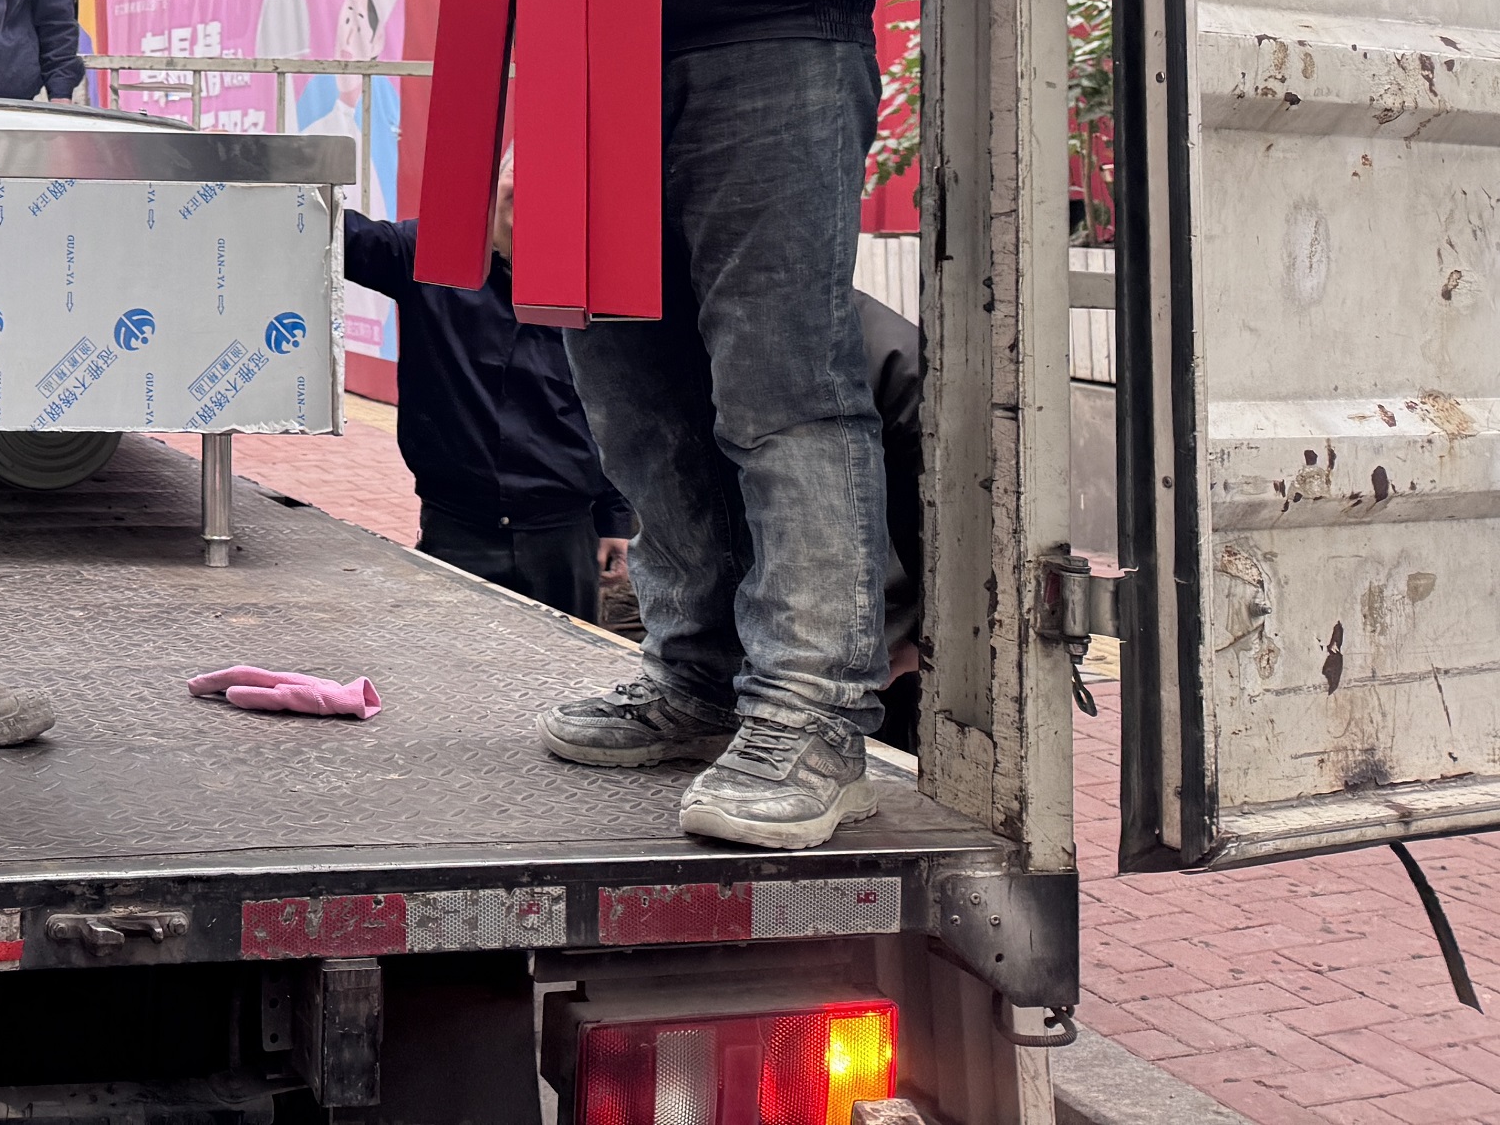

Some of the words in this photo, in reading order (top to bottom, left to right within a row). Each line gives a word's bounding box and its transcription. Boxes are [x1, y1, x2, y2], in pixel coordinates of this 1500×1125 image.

[28, 179, 76, 216] 钢正材
[178, 182, 226, 220] 钢正材
[66, 235, 75, 287] GUAN-YA
[217, 238, 226, 290] GUAN-YA
[145, 372, 154, 426] GUAN-YA
[182, 347, 270, 431] 冠雅不锈钢正
